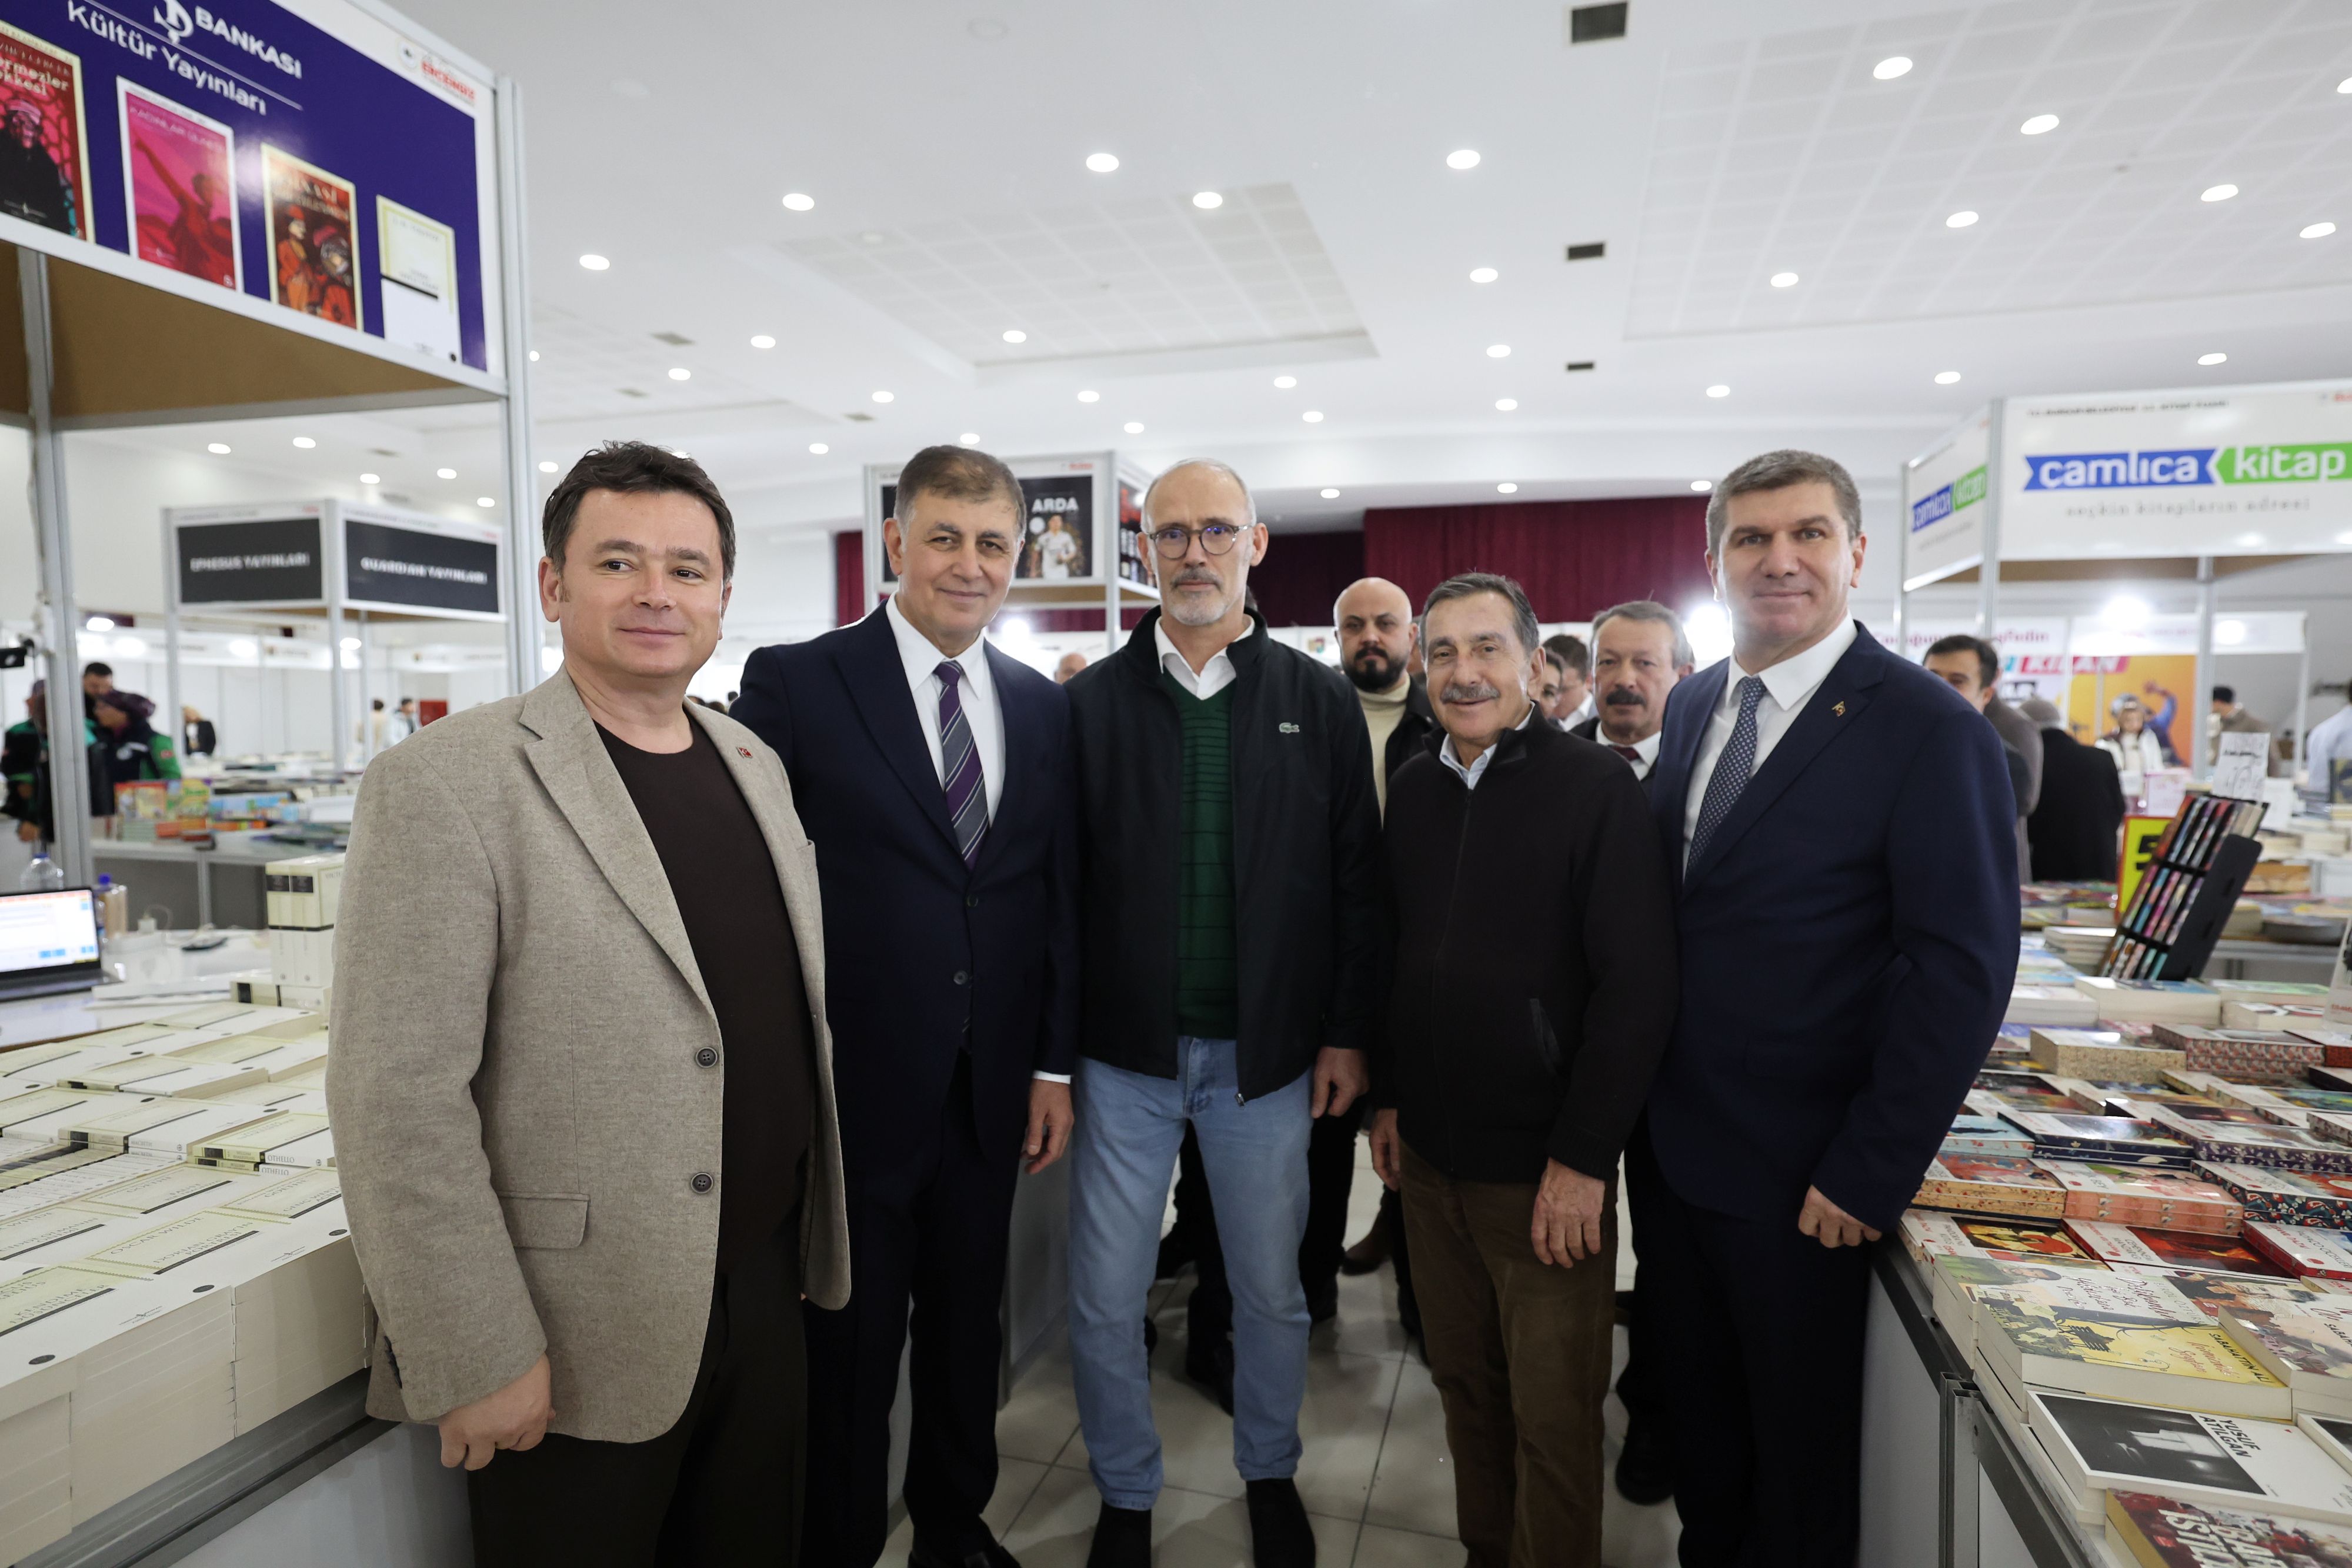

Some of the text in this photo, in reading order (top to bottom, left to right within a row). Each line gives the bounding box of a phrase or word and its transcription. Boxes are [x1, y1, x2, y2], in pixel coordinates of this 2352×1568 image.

[195, 5, 302, 79] BANKASI
[67, 0, 158, 61] Kültür
[161, 46, 267, 116] Yayınları
[2234, 445, 2347, 483] kitap
[1032, 497, 1079, 513] ARDA
[262, 1167, 289, 1176] OTHELLO
[267, 1154, 295, 1164] OTHELLO
[7, 1212, 53, 1227] WILDE
[110, 1216, 204, 1255] OSCAR WILDE
[153, 1241, 205, 1263] DORIAN
[14, 1287, 87, 1316] KENDİME
[2208, 1332, 2260, 1372] SABAHATTİN
[2198, 1415, 2252, 1458] ATILGAN
[2219, 1419, 2261, 1450] YUSUF
